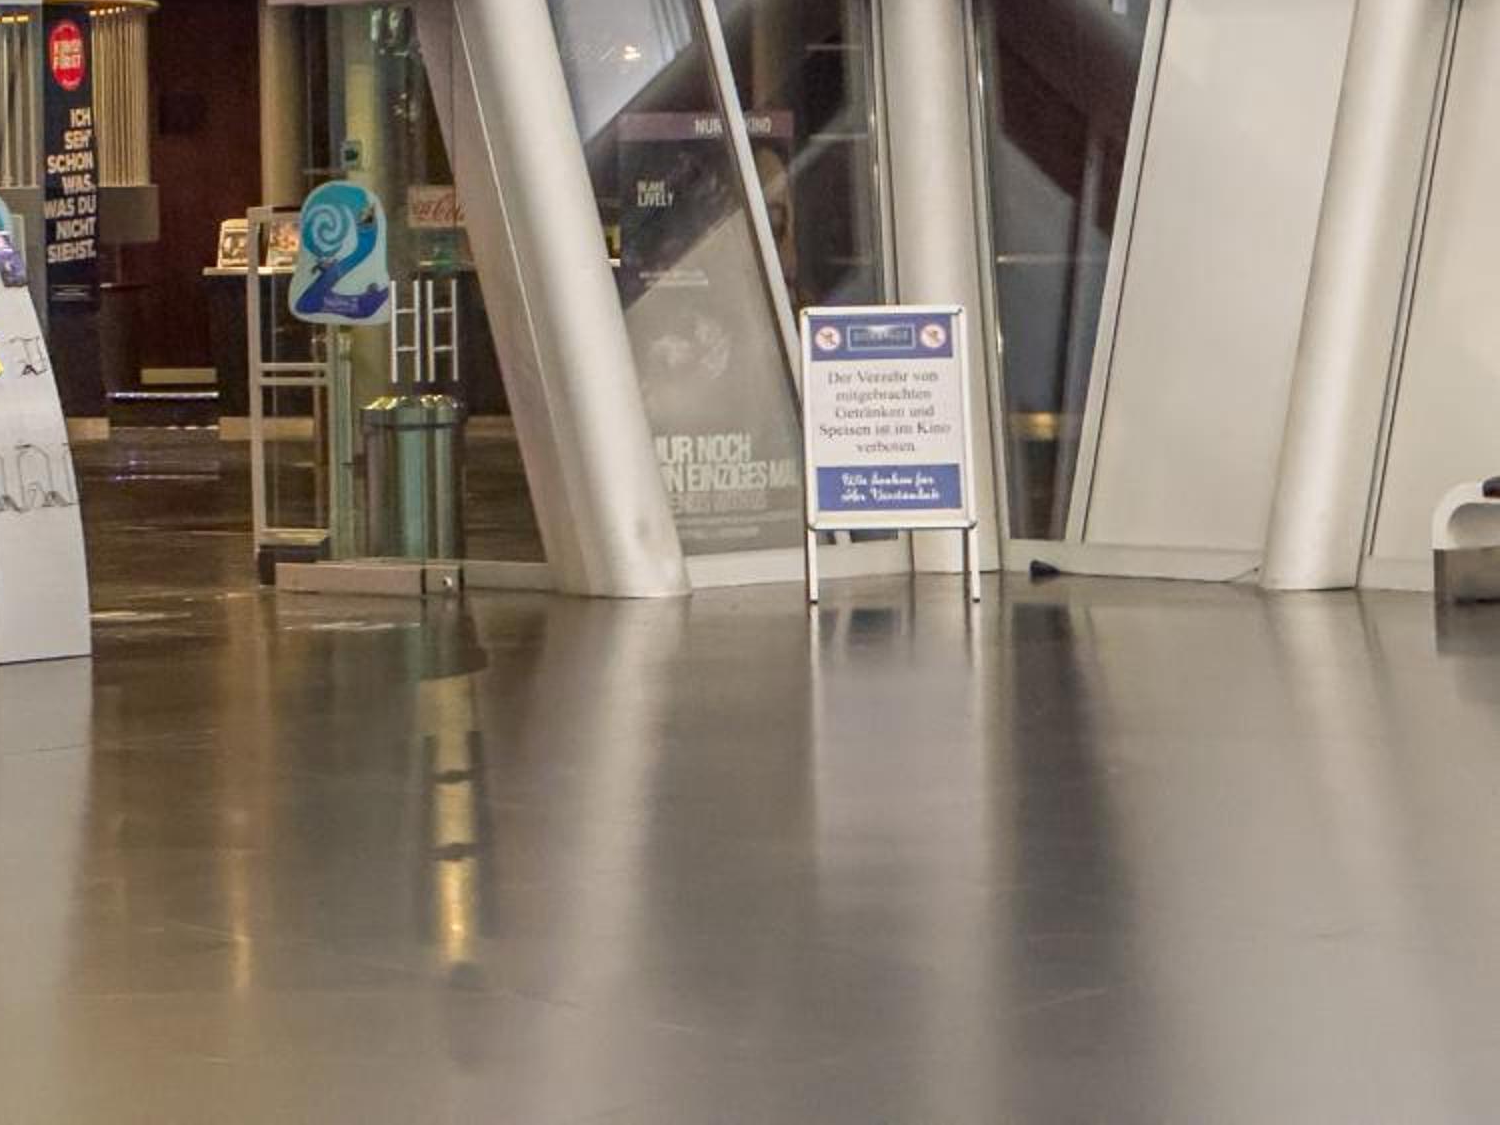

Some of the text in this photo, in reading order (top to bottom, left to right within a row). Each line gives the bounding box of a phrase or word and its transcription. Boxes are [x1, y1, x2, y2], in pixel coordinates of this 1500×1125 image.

[70, 108, 91, 127] ICH
[47, 153, 94, 175] SCHON
[44, 195, 97, 220] WAS DU
[55, 217, 97, 241] NICHT
[912, 371, 939, 383] von
[835, 388, 932, 404] mitgebrachten
[909, 403, 935, 418] und
[819, 423, 871, 439] Speisen
[917, 421, 952, 435] Kino
[697, 432, 752, 464] NOCH
